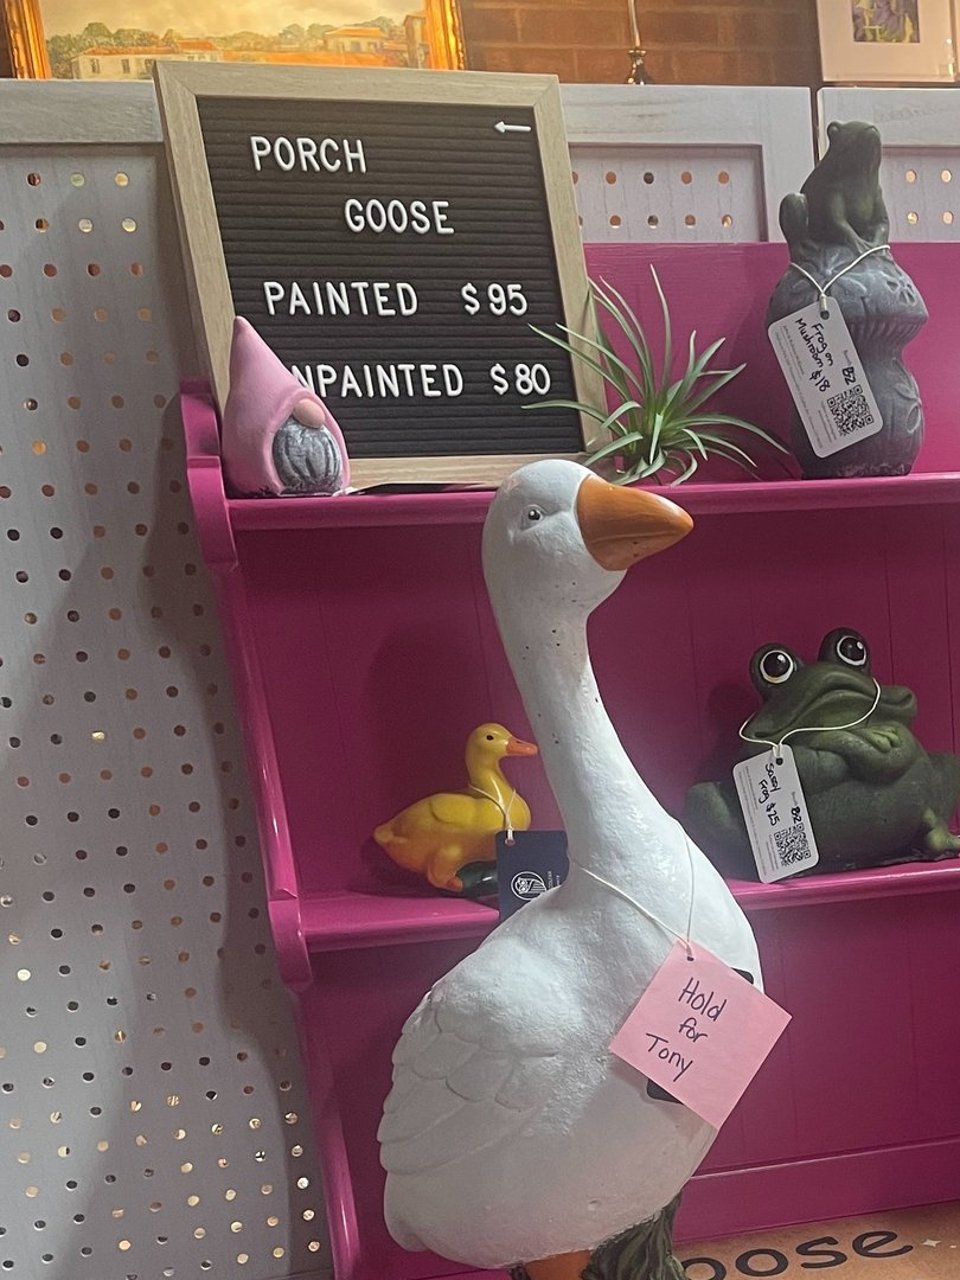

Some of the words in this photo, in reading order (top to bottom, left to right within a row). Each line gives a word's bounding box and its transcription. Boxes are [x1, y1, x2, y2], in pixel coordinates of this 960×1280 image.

[250, 135, 367, 174] PORCH
[344, 198, 455, 235] GOOSE
[263, 281, 418, 317] PAINTED
[461, 282, 529, 317] $95
[795, 318, 824, 368] Mushroom
[811, 322, 828, 354] Frog
[825, 352, 834, 367] on
[290, 363, 464, 398] NPAINTED
[489, 362, 552, 397] $80
[809, 369, 831, 392] $18
[758, 779, 770, 804] Frog
[766, 802, 781, 826] $25
[677, 976, 728, 1022] Hold
[678, 1016, 709, 1043] for
[645, 1032, 694, 1083] Tony
